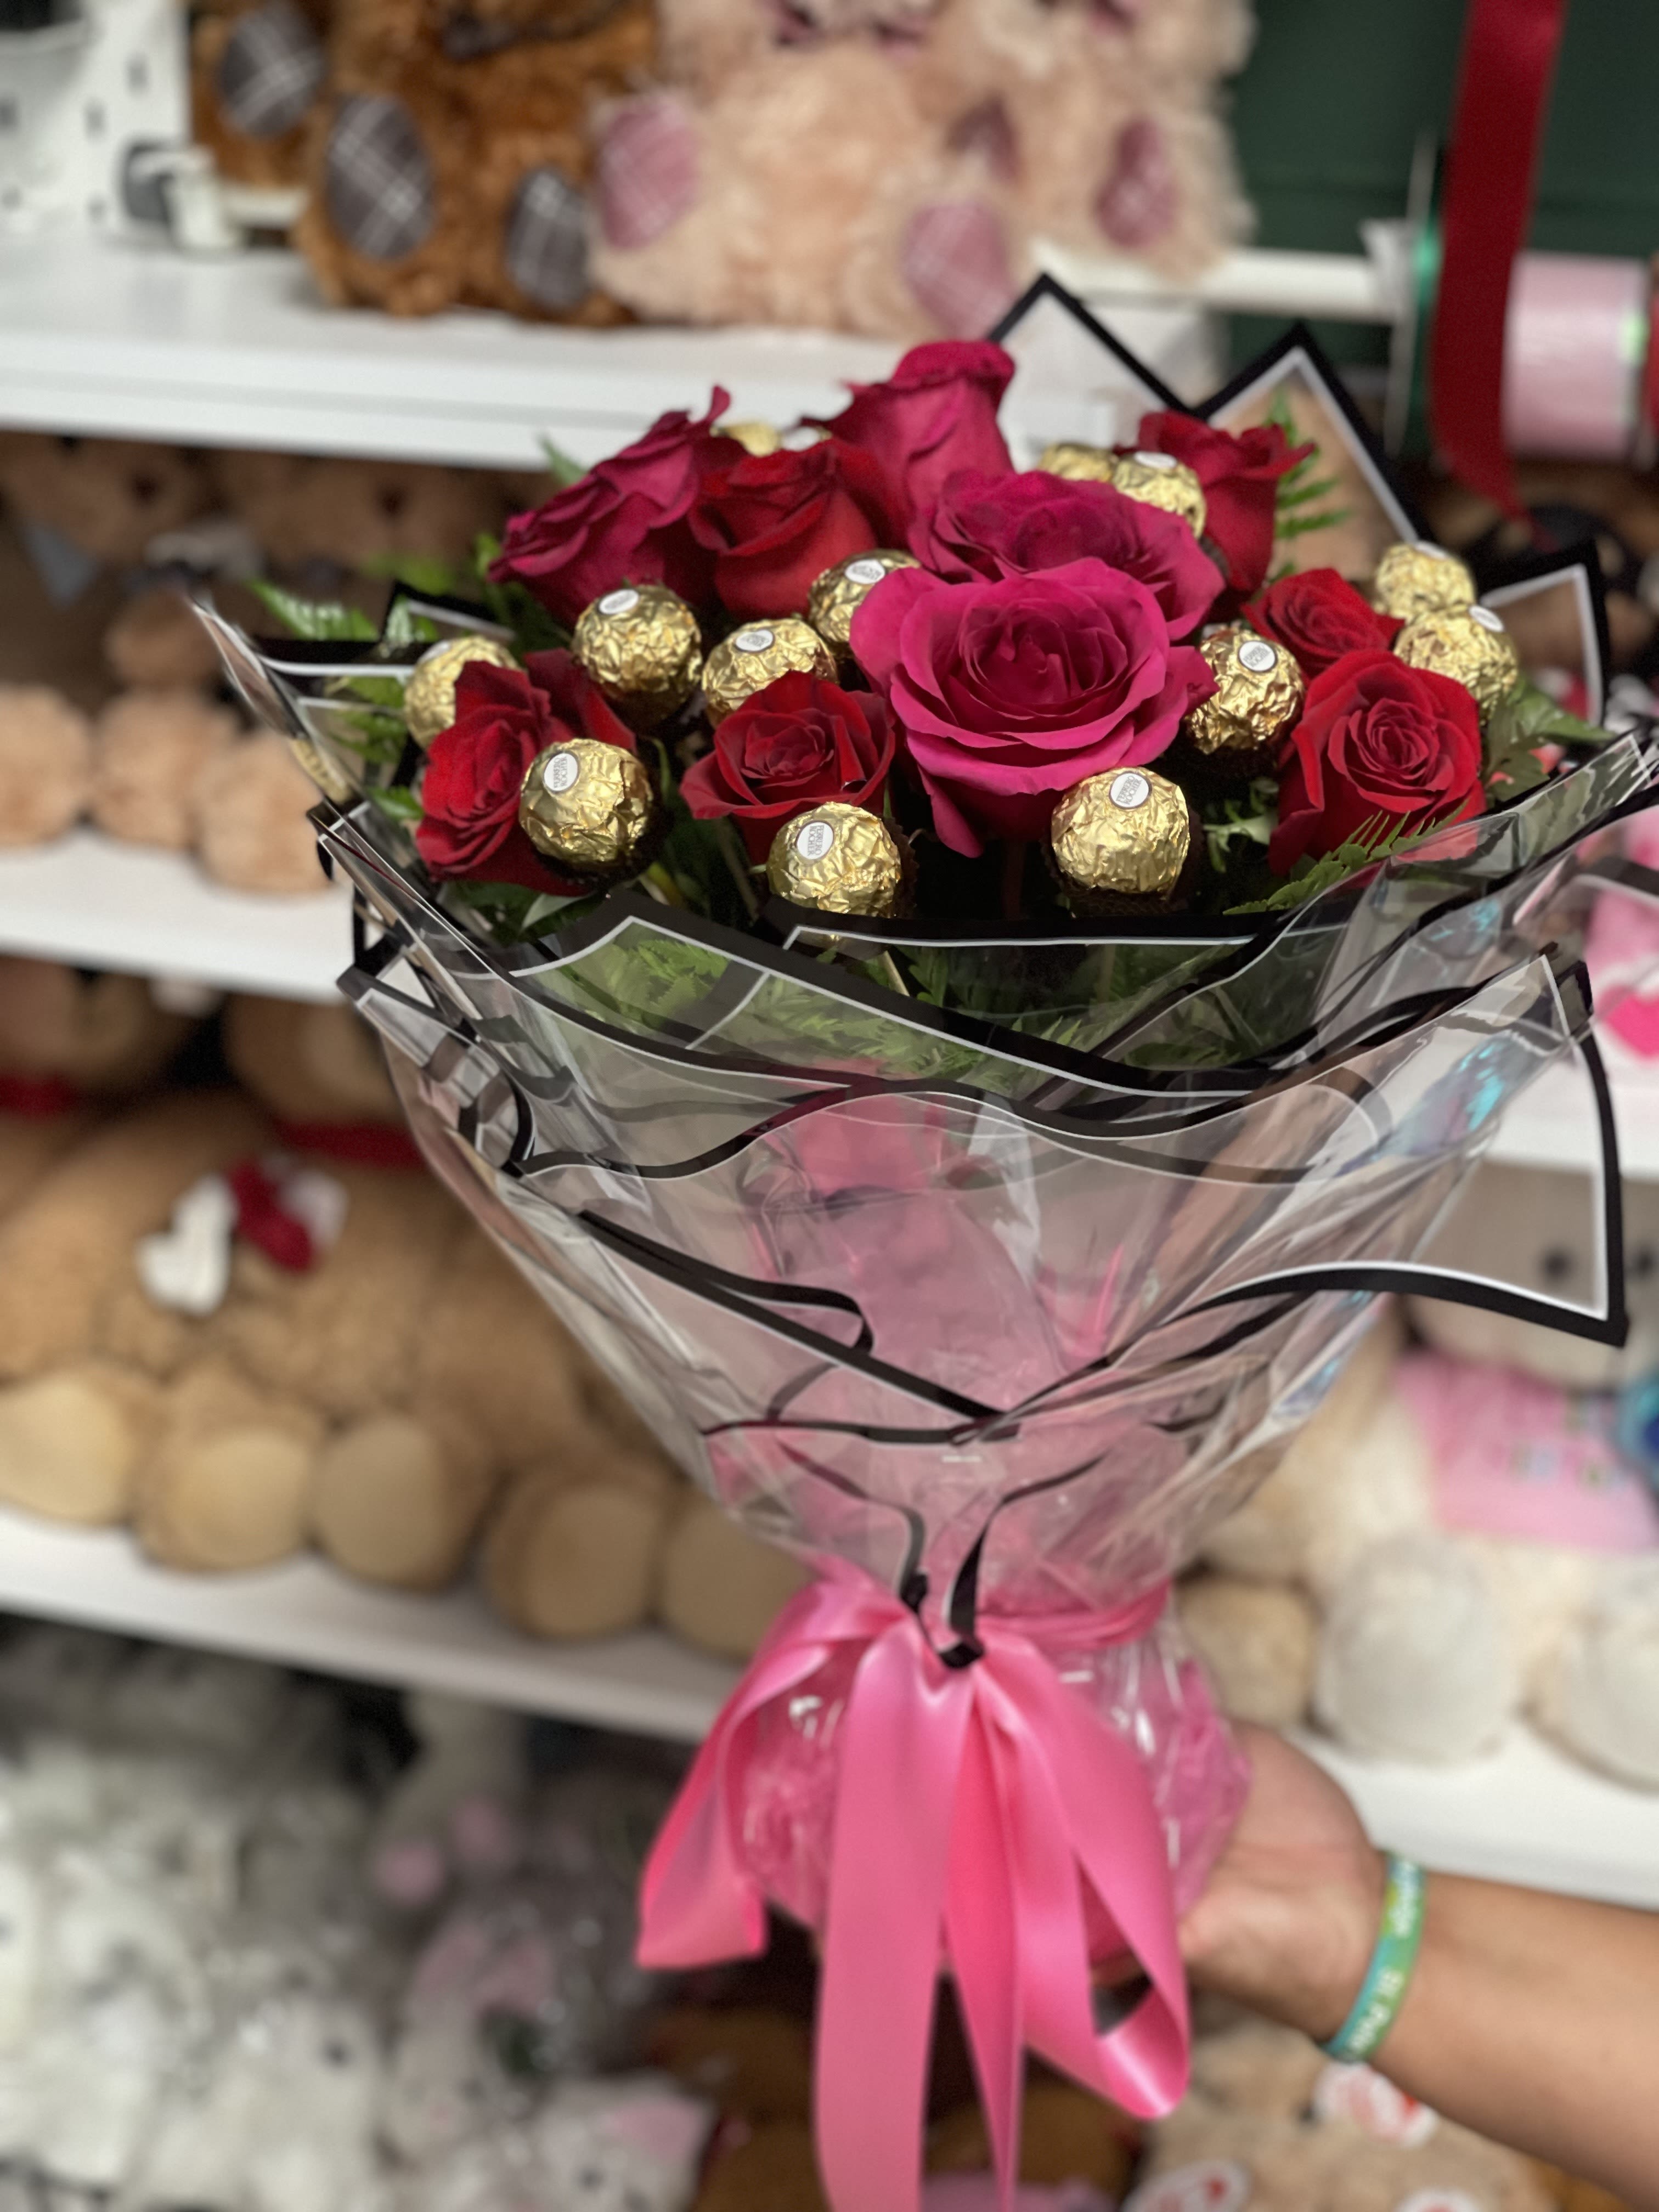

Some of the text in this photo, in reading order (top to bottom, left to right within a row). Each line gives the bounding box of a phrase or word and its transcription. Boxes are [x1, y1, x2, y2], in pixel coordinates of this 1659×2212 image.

[1116, 775, 1136, 802] FERRERO
[1125, 778, 1142, 805] ROCHER
[808, 825, 816, 856] ROCHER
[815, 825, 825, 855] FERRERO
